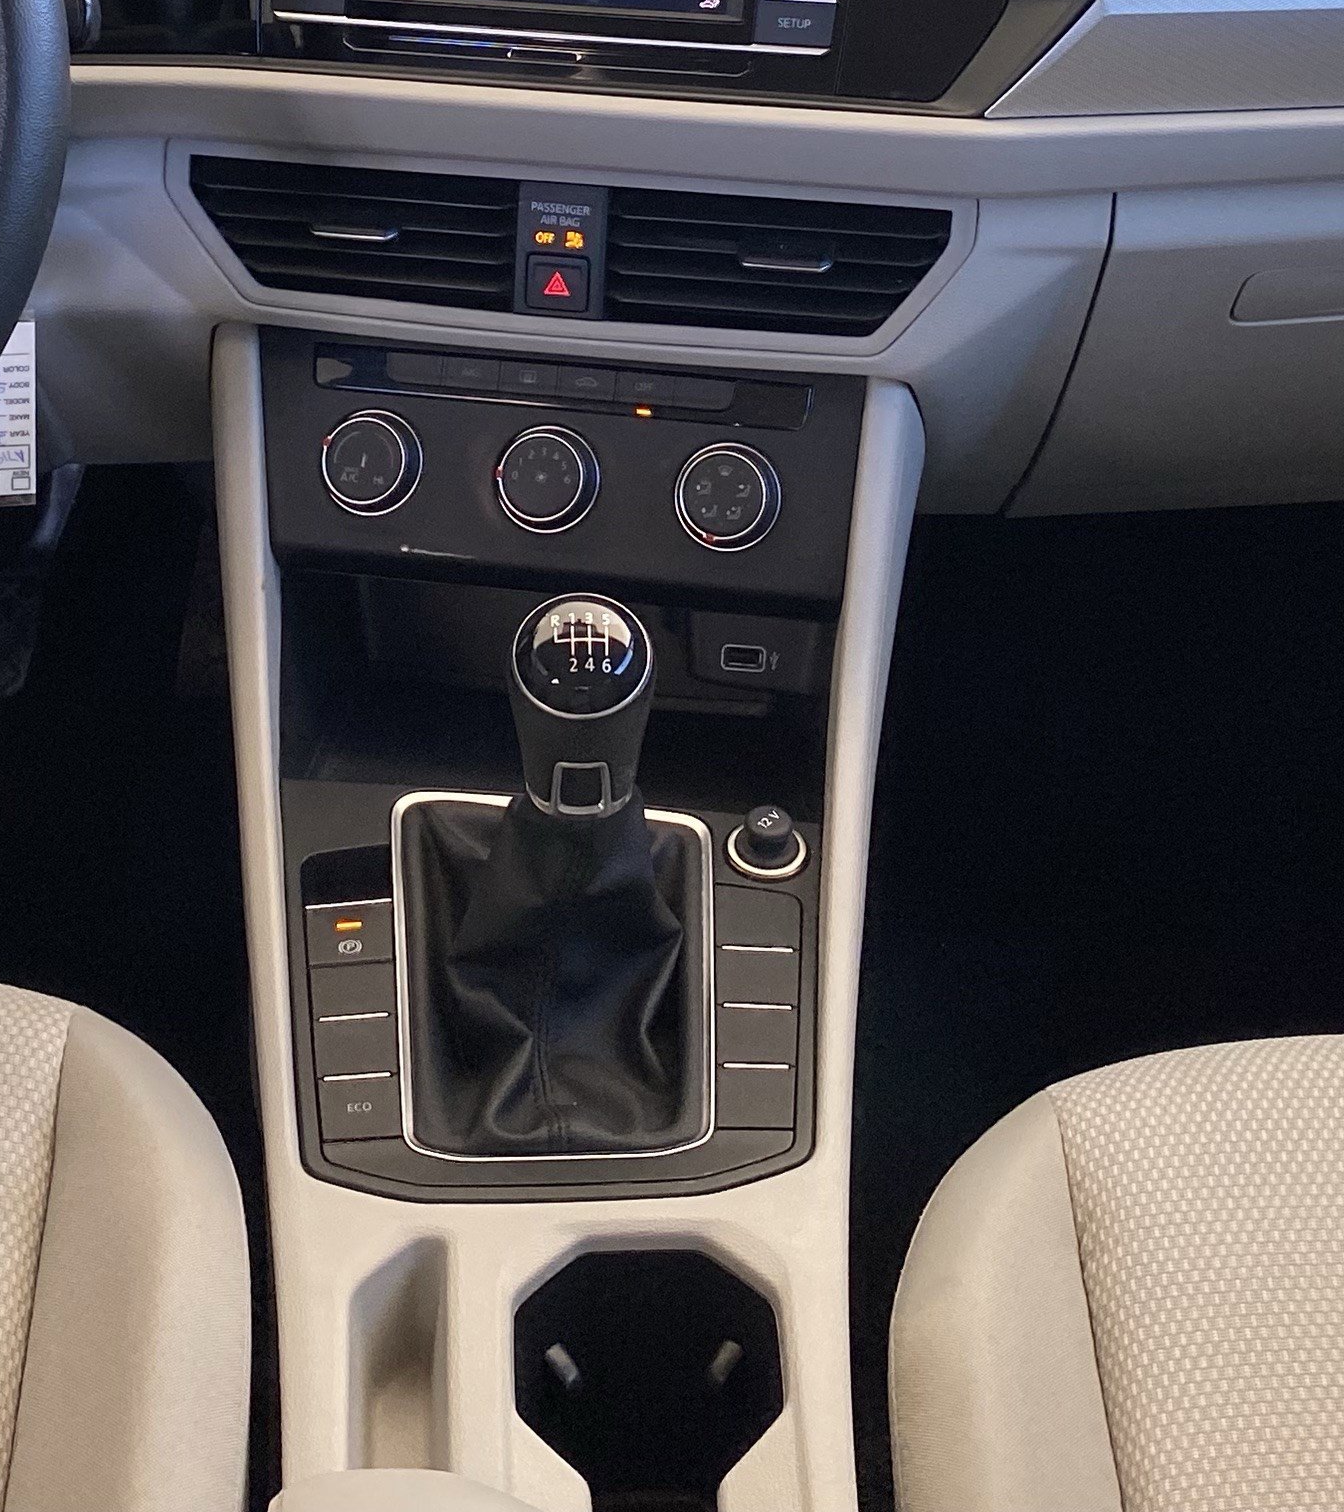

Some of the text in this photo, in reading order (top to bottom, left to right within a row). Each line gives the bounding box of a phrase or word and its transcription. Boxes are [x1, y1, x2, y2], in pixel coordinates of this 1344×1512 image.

[777, 17, 812, 30] SETUP
[531, 201, 591, 216] PASSENGER
[540, 214, 580, 228] AIR BAG
[535, 231, 556, 244] OFF
[550, 612, 611, 628] R 1 3 5
[568, 657, 612, 674] 2 4 6
[757, 815, 773, 829] 12
[346, 1101, 373, 1113] ECO
